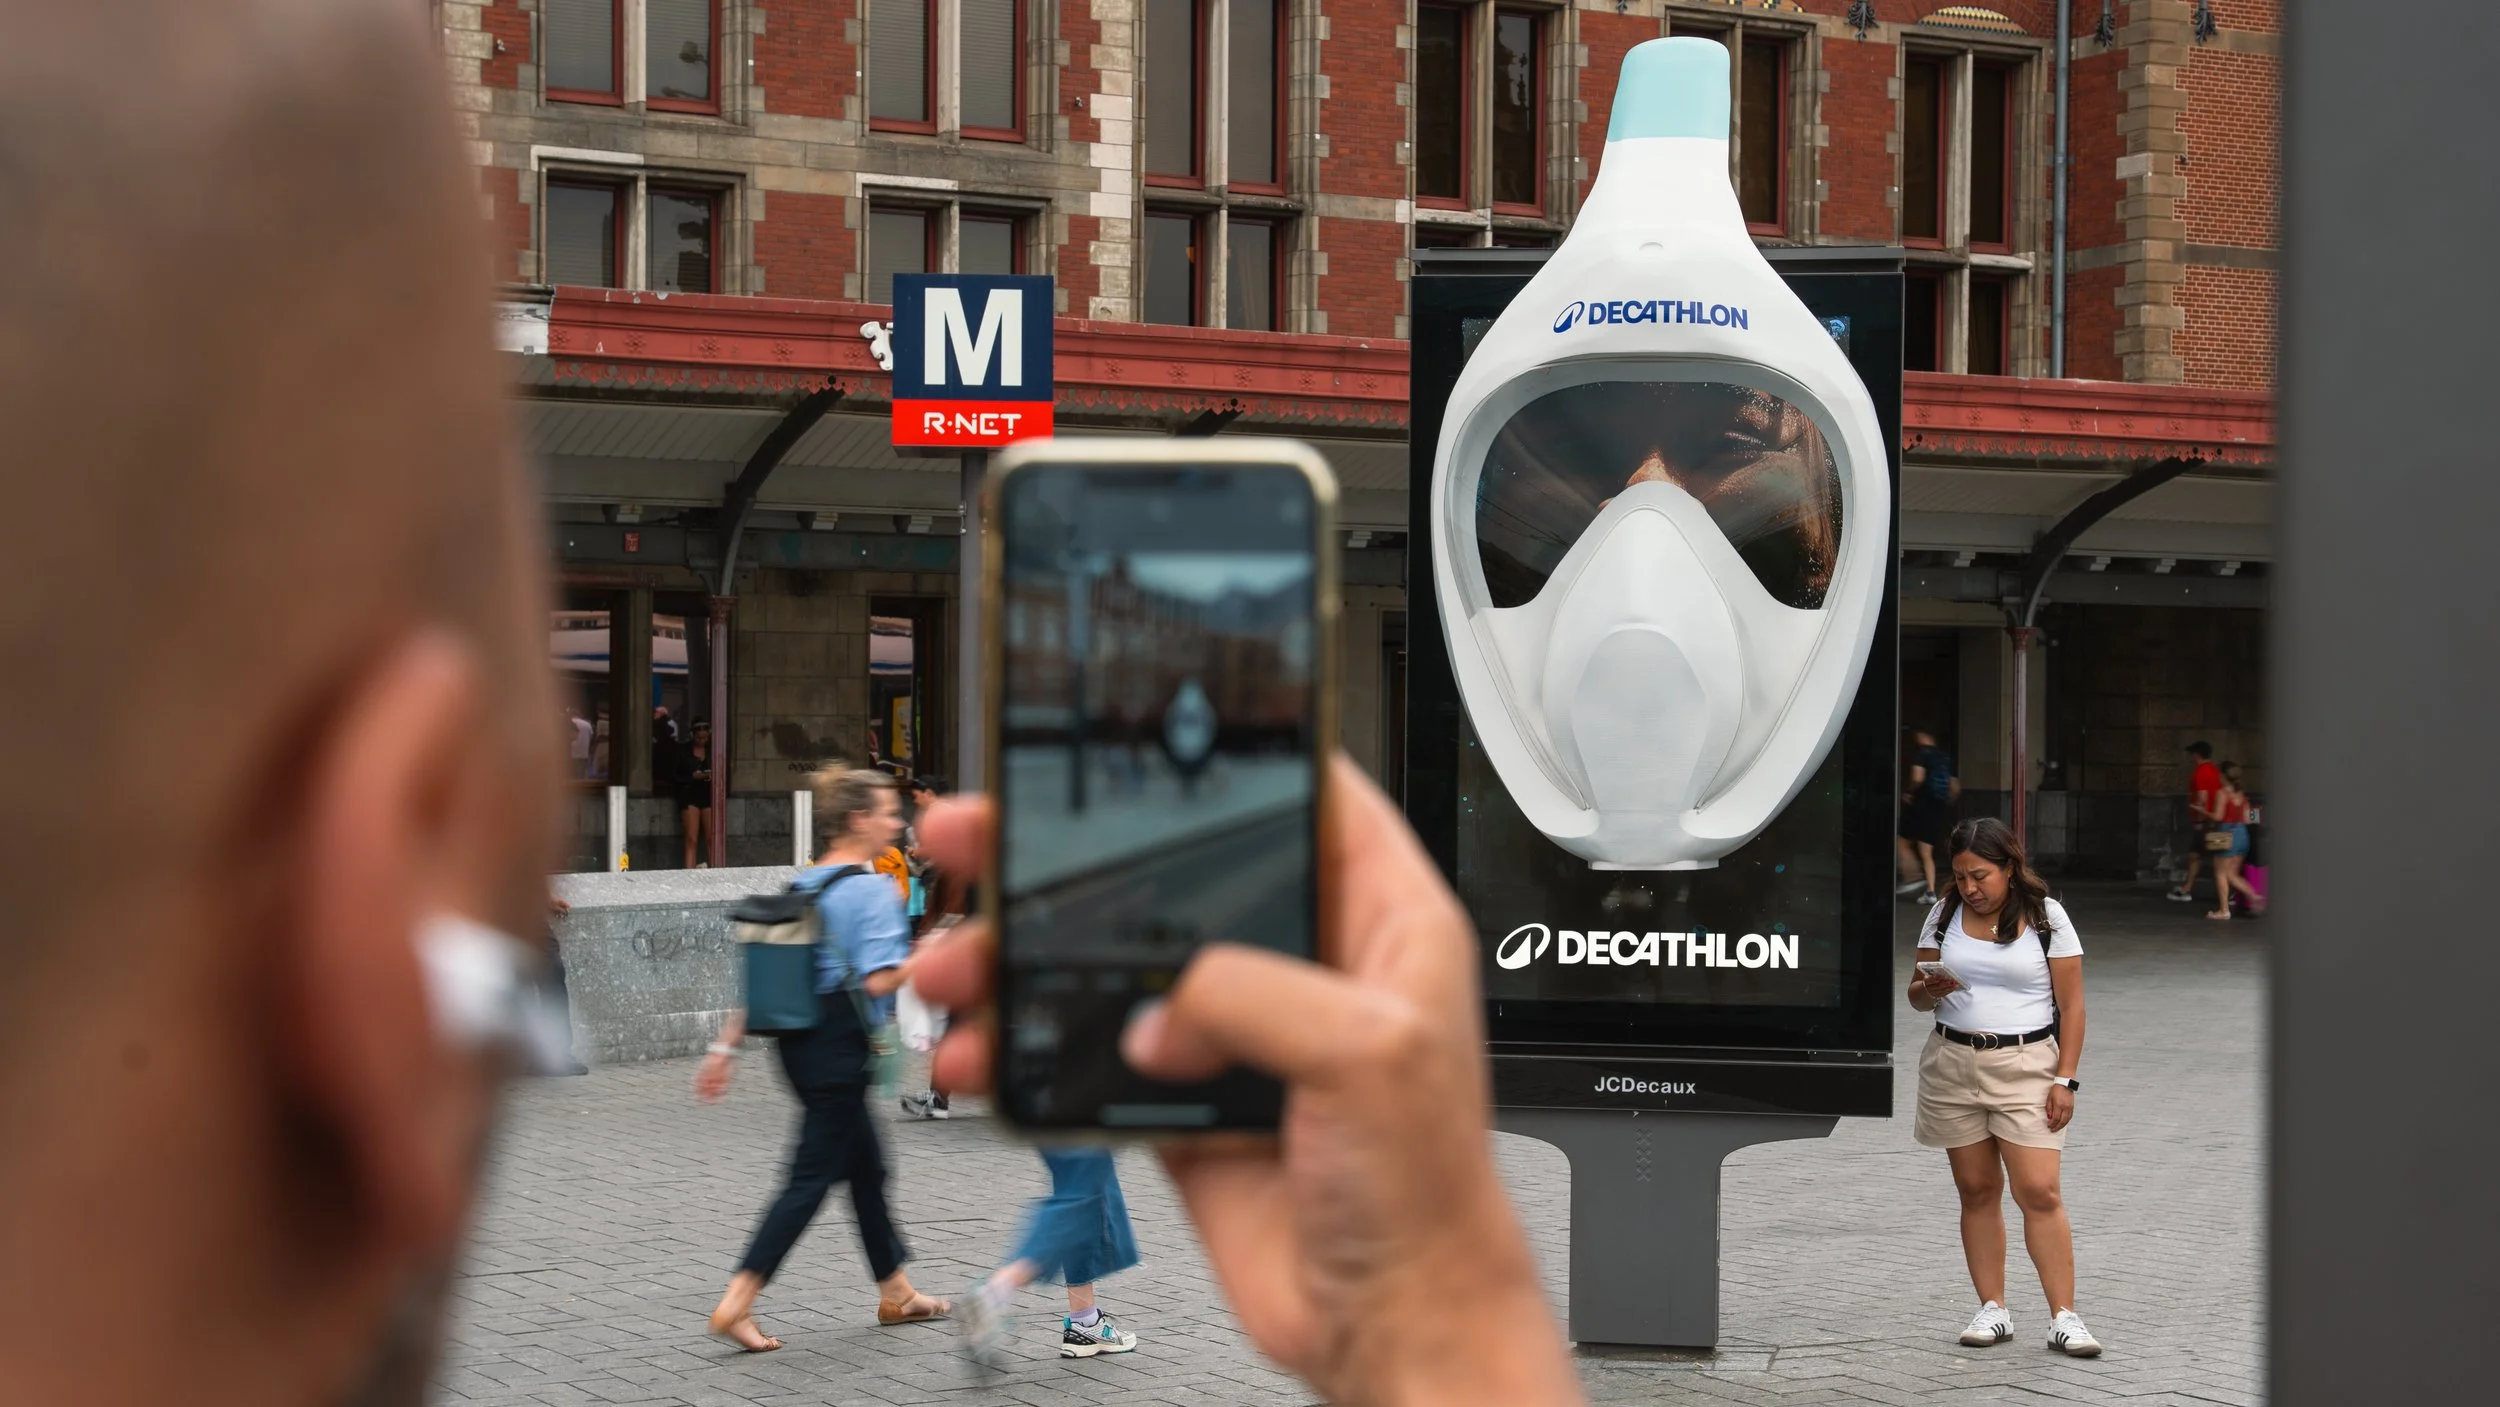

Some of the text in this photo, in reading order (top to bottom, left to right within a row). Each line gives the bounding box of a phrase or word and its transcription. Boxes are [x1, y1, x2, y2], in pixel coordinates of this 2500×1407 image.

[1588, 300, 1748, 330] DECATHLON
[925, 288, 1022, 386] M
[1557, 930, 1799, 969] DECATHLON
[1594, 1076, 1696, 1095] JCDecaux
